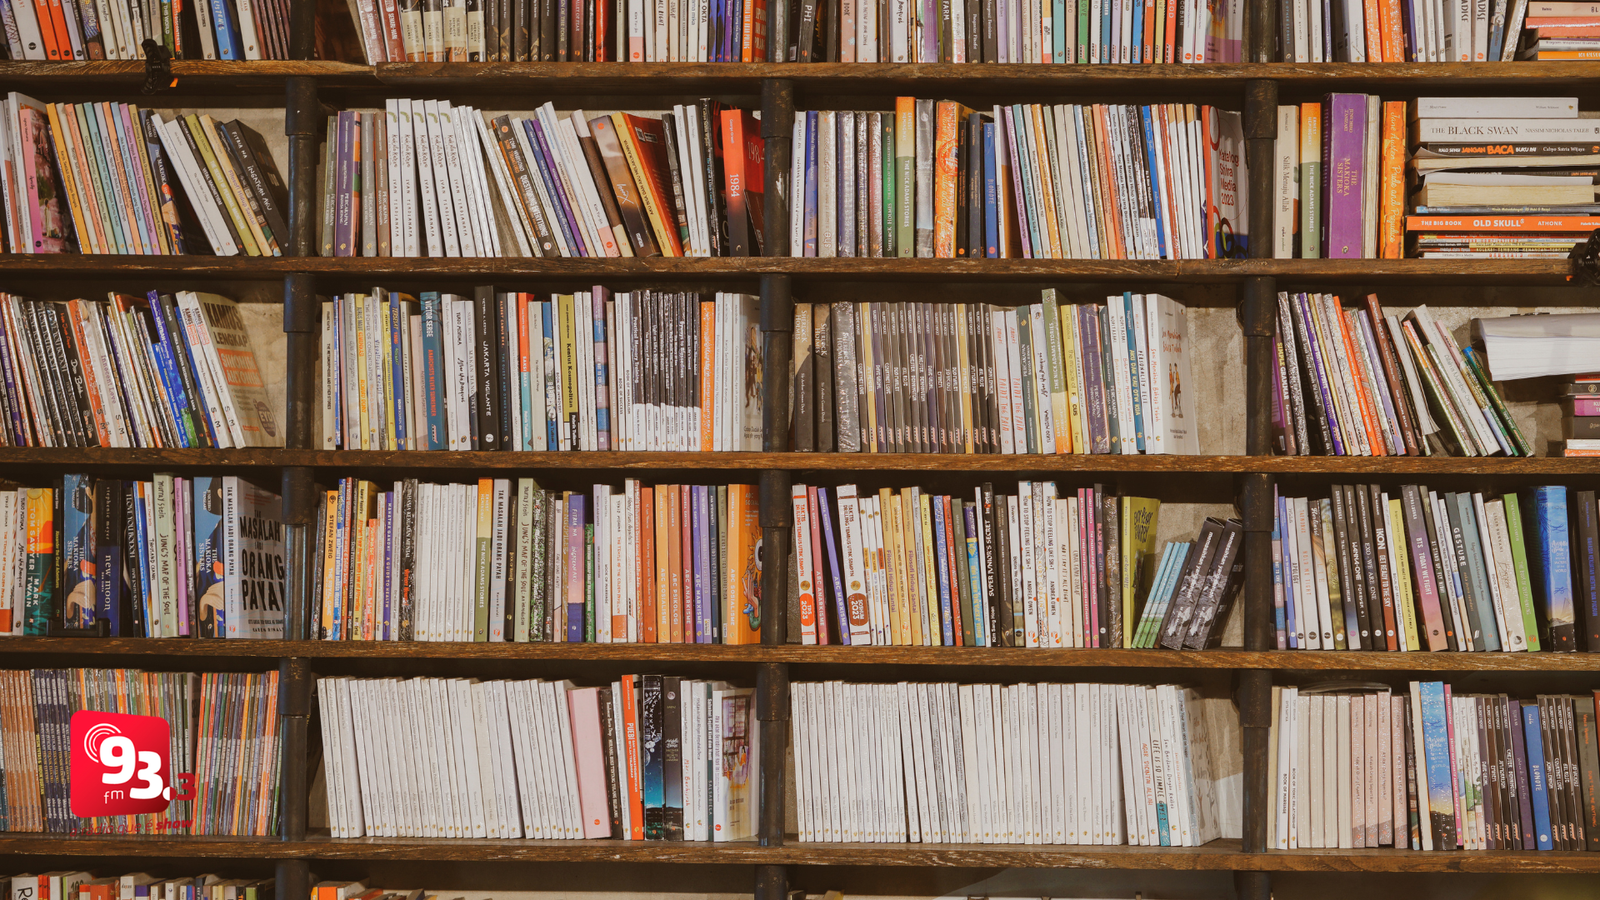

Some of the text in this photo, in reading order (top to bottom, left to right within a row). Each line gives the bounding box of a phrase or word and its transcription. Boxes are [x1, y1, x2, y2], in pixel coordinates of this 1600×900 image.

[804, 5, 812, 22] PHI
[1390, 113, 1400, 160] Jane Austen
[1448, 126, 1484, 135] BLACK
[1487, 126, 1519, 135] SWAN
[1487, 145, 1514, 154] BACA
[730, 174, 740, 197] 1984
[1221, 178, 1236, 192] Media
[1281, 172, 1289, 194] Menuju
[522, 175, 549, 238] QUESTIONING EVERYTHING!
[1221, 193, 1234, 206] 2023
[1387, 166, 1401, 242] Pride and Prejudice
[185, 308, 193, 325] KAMUS
[204, 302, 243, 331] KAMUS
[425, 300, 434, 337] VICTOR SERGE
[213, 332, 247, 347] LENGKAP
[221, 353, 257, 370] SINONIM
[1277, 342, 1289, 400] SIMPLE GRAMMAR
[226, 370, 262, 385] ANTONIM
[566, 366, 574, 408] Kosmopolitan
[240, 517, 280, 542] MASALAH
[160, 534, 168, 558] JUNG'S
[1454, 527, 1466, 566] GESTURE
[242, 548, 284, 580] ORANG
[1366, 560, 1372, 569] WE
[1419, 552, 1427, 569] TODAY
[103, 555, 112, 611] new moon
[163, 577, 170, 585] OF
[1421, 570, 1428, 579] WE
[1424, 580, 1432, 595] FIGHT
[837, 592, 846, 626] MARXISME
[1155, 765, 1161, 773] SO
[1533, 765, 1542, 791] BLONOTE
